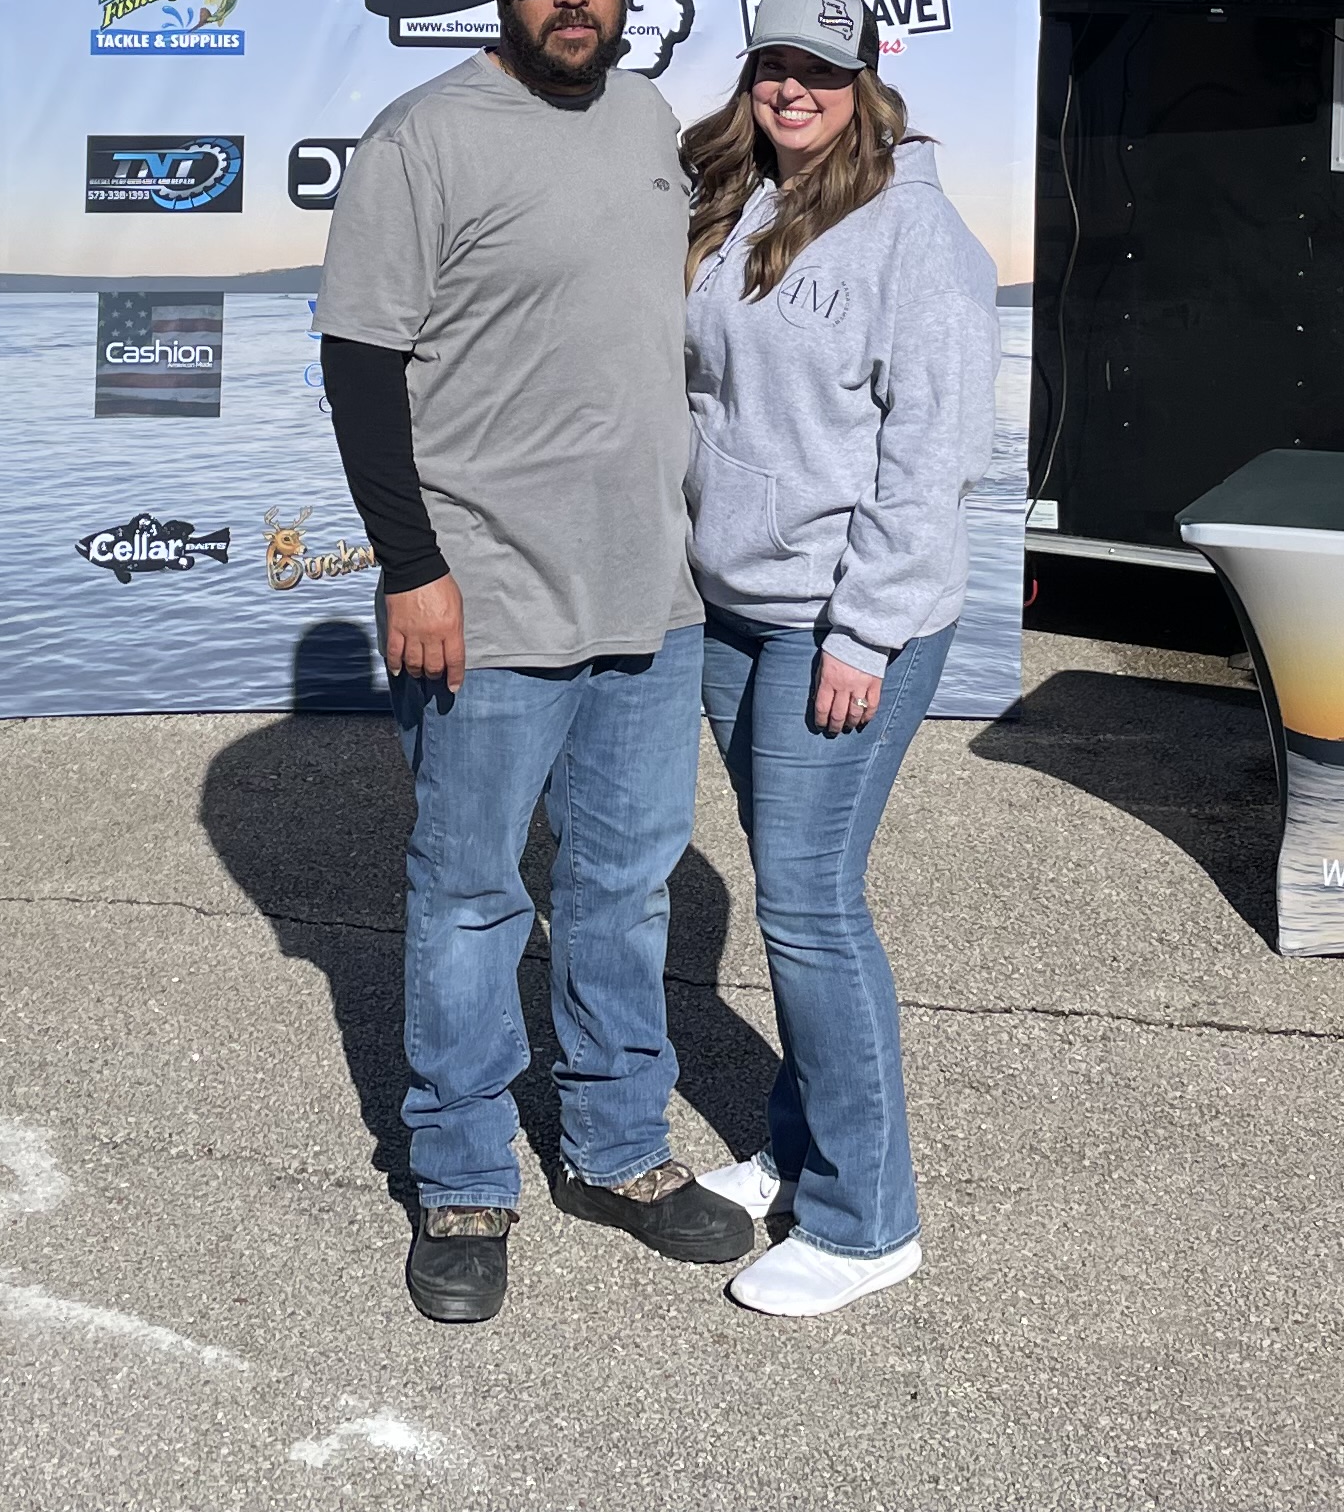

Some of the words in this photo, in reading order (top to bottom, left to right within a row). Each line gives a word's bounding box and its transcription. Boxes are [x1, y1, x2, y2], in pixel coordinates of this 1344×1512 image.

[96, 34, 149, 48] TACKLE
[154, 34, 166, 48] &
[170, 34, 240, 48] SUPPLIES
[106, 339, 213, 363] Cashion
[89, 533, 183, 561] Cellar
[185, 542, 227, 550] BAITS
